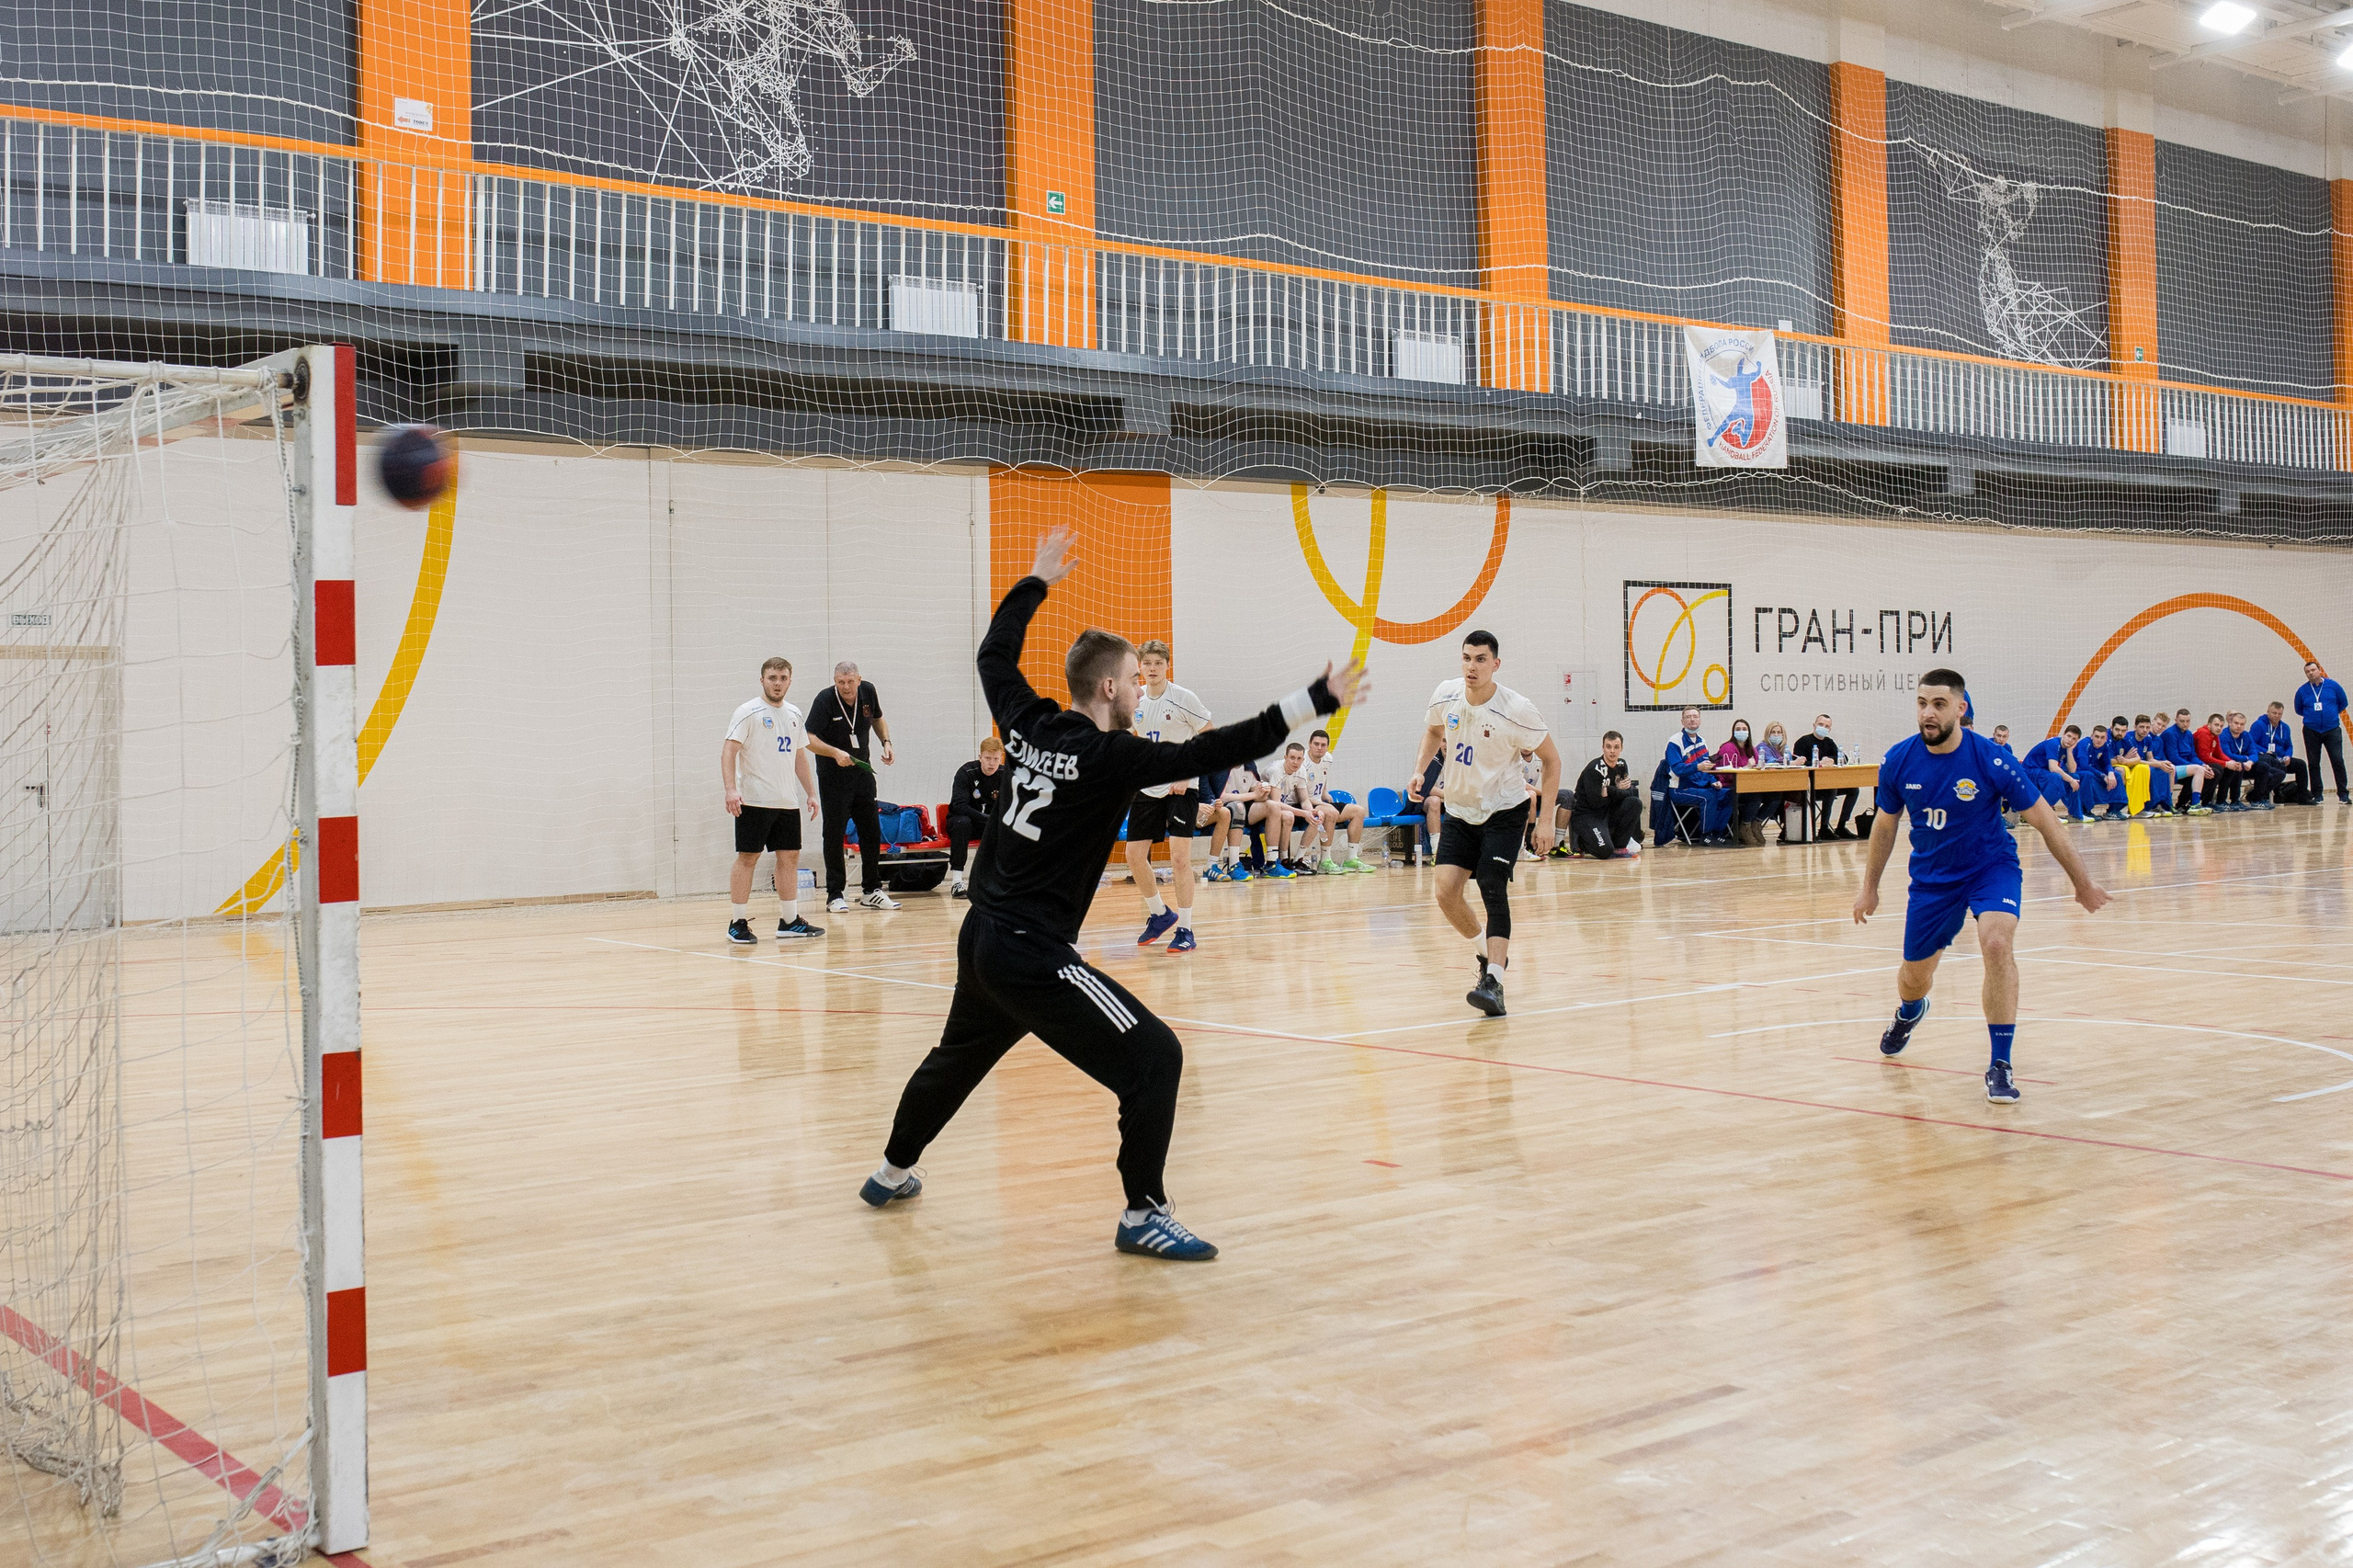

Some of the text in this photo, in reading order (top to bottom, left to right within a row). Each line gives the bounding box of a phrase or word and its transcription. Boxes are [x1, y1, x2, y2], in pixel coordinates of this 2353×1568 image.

[1719, 441, 1751, 461] HANDBALL
[1752, 419, 1779, 460] FEDERATION
[1766, 369, 1779, 403] RUSSIA
[1755, 607, 1953, 654] ГРАН-ПРИ
[1760, 669, 1886, 692] СПОРТИВНЫЙ
[777, 736, 791, 753] 22
[1146, 731, 1161, 742] 17
[1005, 729, 1079, 780] ЕЛИСЕЕВ
[1455, 743, 1473, 767] 20
[1313, 782, 1324, 796] 27
[1002, 766, 1056, 842] 12
[1922, 807, 1948, 831] 10
